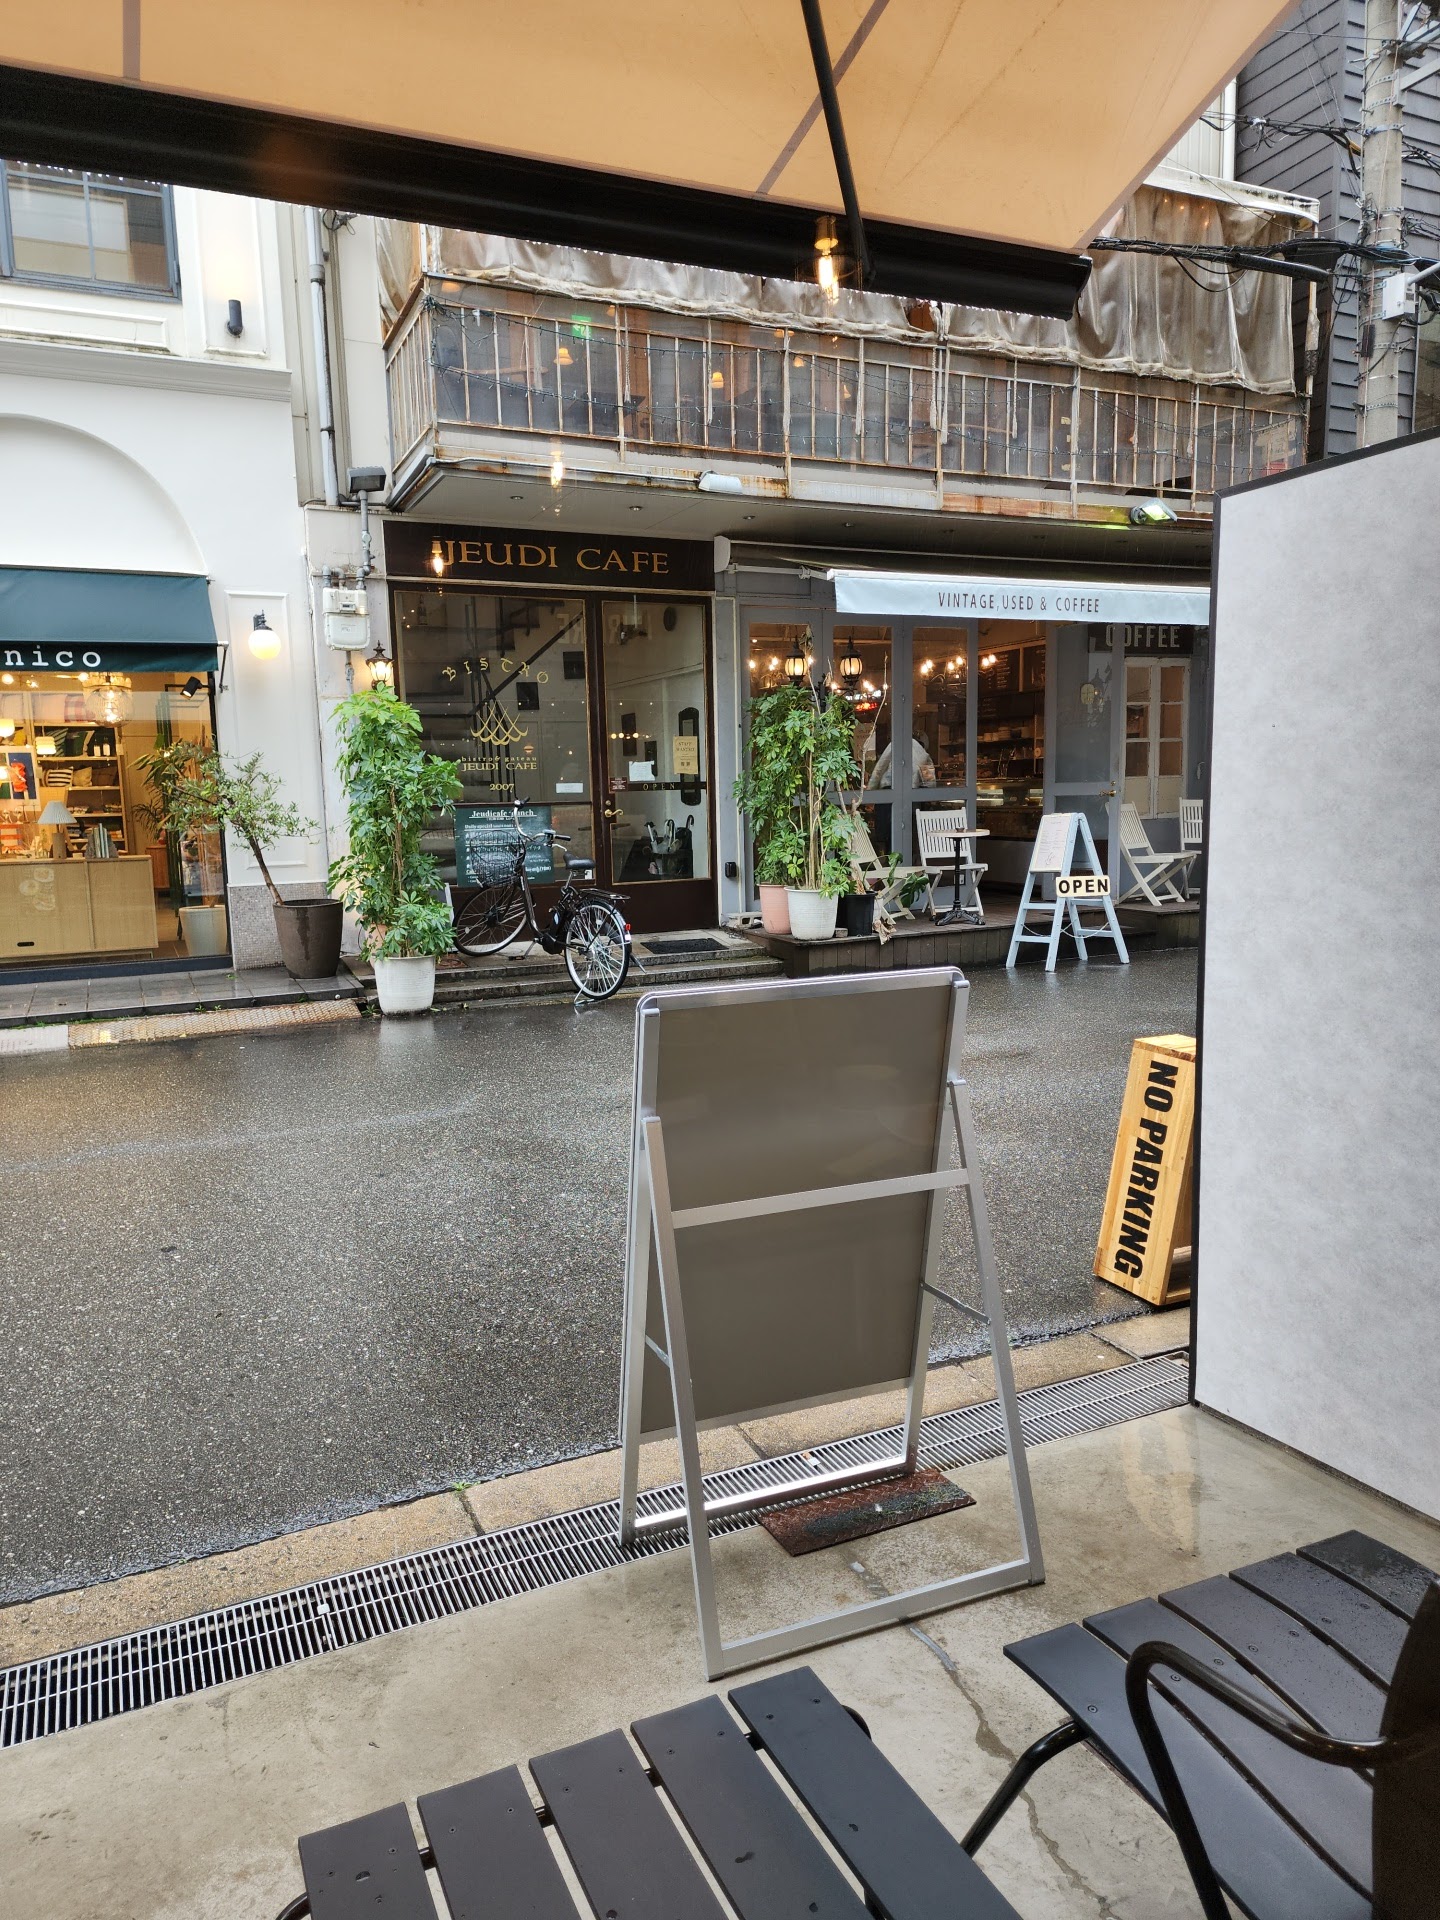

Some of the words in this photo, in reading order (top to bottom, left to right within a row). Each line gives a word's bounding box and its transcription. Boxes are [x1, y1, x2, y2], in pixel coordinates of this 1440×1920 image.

[442, 540, 558, 568] JEUDI
[576, 548, 670, 574] CAFE
[1040, 596, 1047, 611] &
[1055, 597, 1100, 613] COFFEE
[3, 644, 102, 668] nico
[461, 762, 499, 771] JEUDI
[505, 762, 538, 770] CAFE
[489, 783, 515, 793] 2007
[642, 783, 675, 791] OPEN
[1058, 878, 1109, 894] OPEN
[1143, 1060, 1179, 1113] NO
[1113, 1117, 1168, 1279] PARKING
